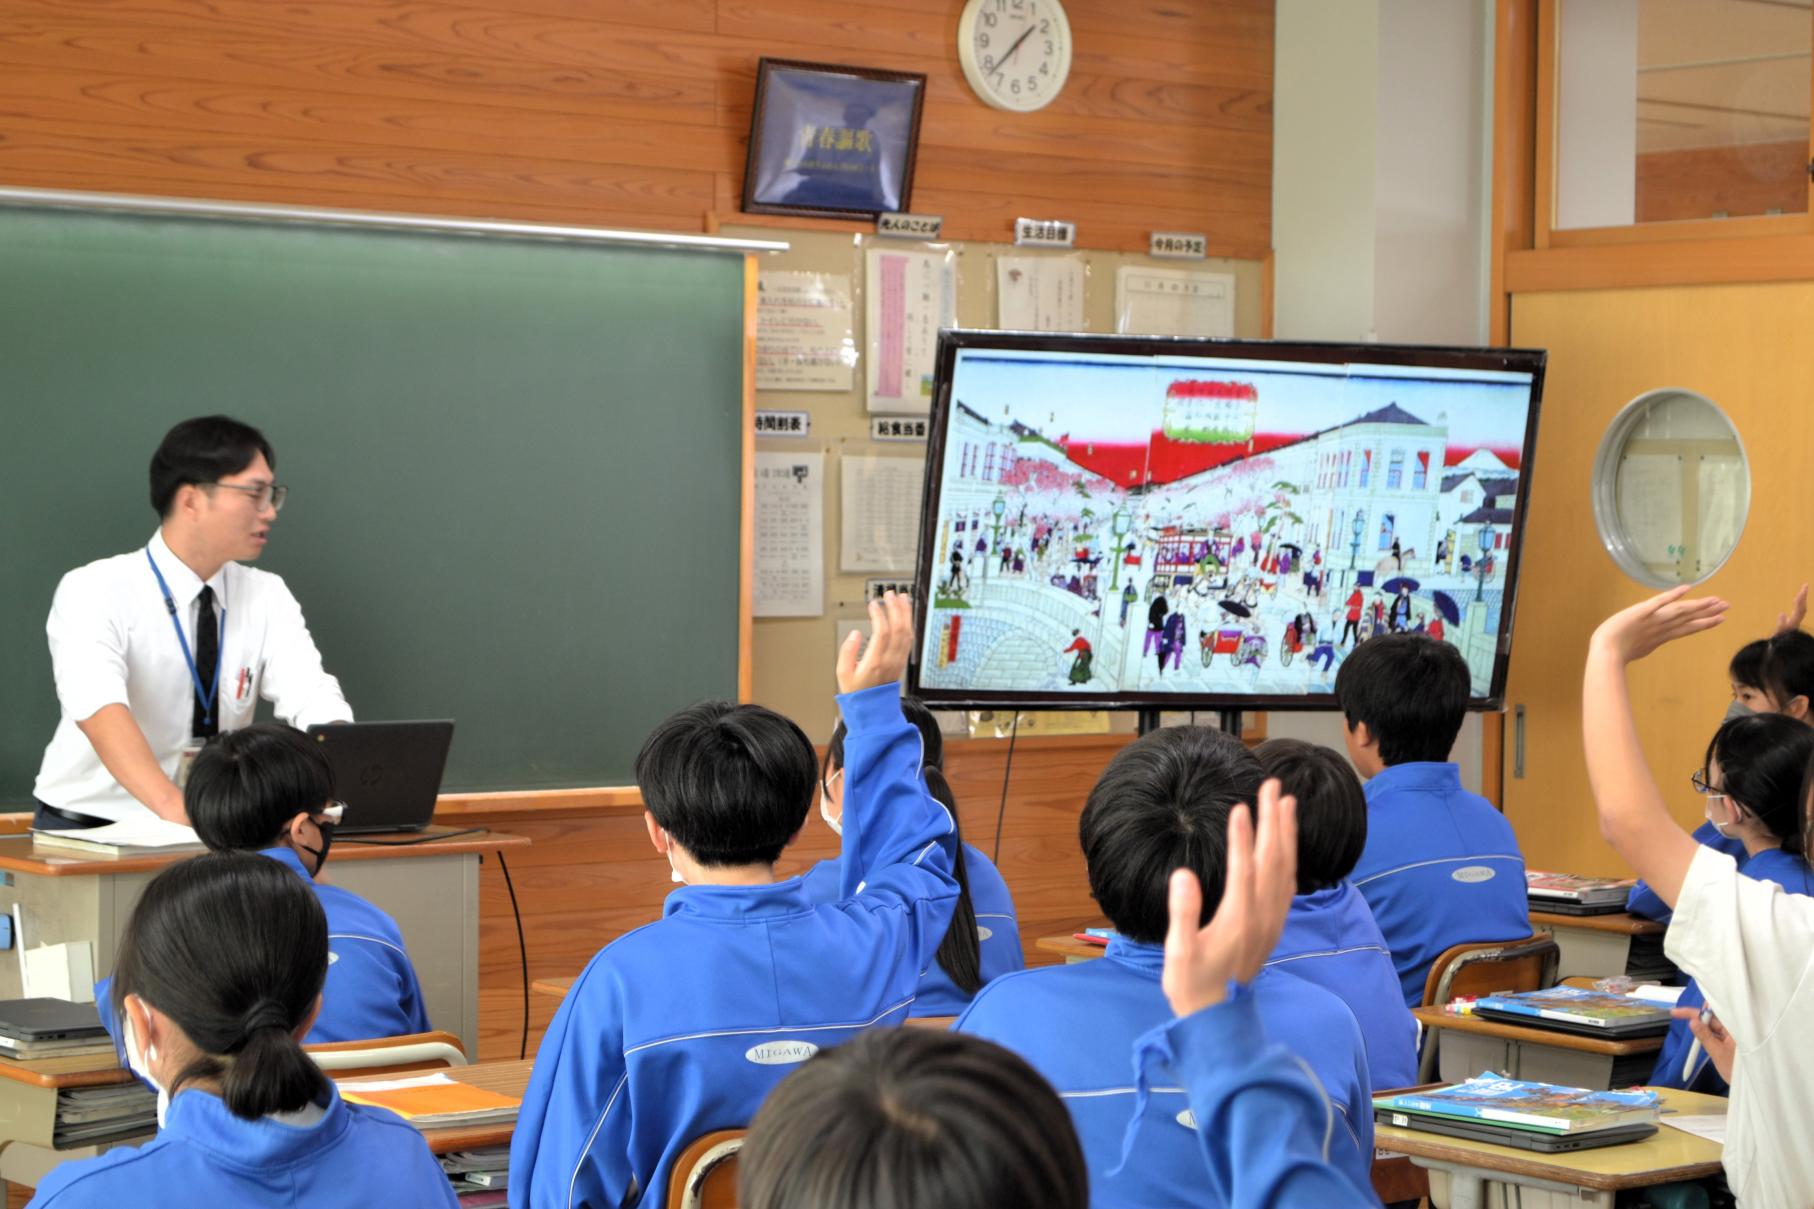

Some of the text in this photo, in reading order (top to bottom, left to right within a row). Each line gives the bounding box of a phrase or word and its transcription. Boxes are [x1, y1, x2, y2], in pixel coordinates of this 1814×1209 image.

[1040, 19, 1049, 34] 2
[980, 33, 990, 48] 9
[1044, 40, 1054, 55] 3
[983, 55, 994, 70] 8
[1039, 61, 1049, 76] 4
[1010, 79, 1021, 94] 6
[1027, 75, 1037, 91] 5
[1155, 238, 1202, 254] 今月の予定
[754, 1046, 813, 1061] MIGAWA
